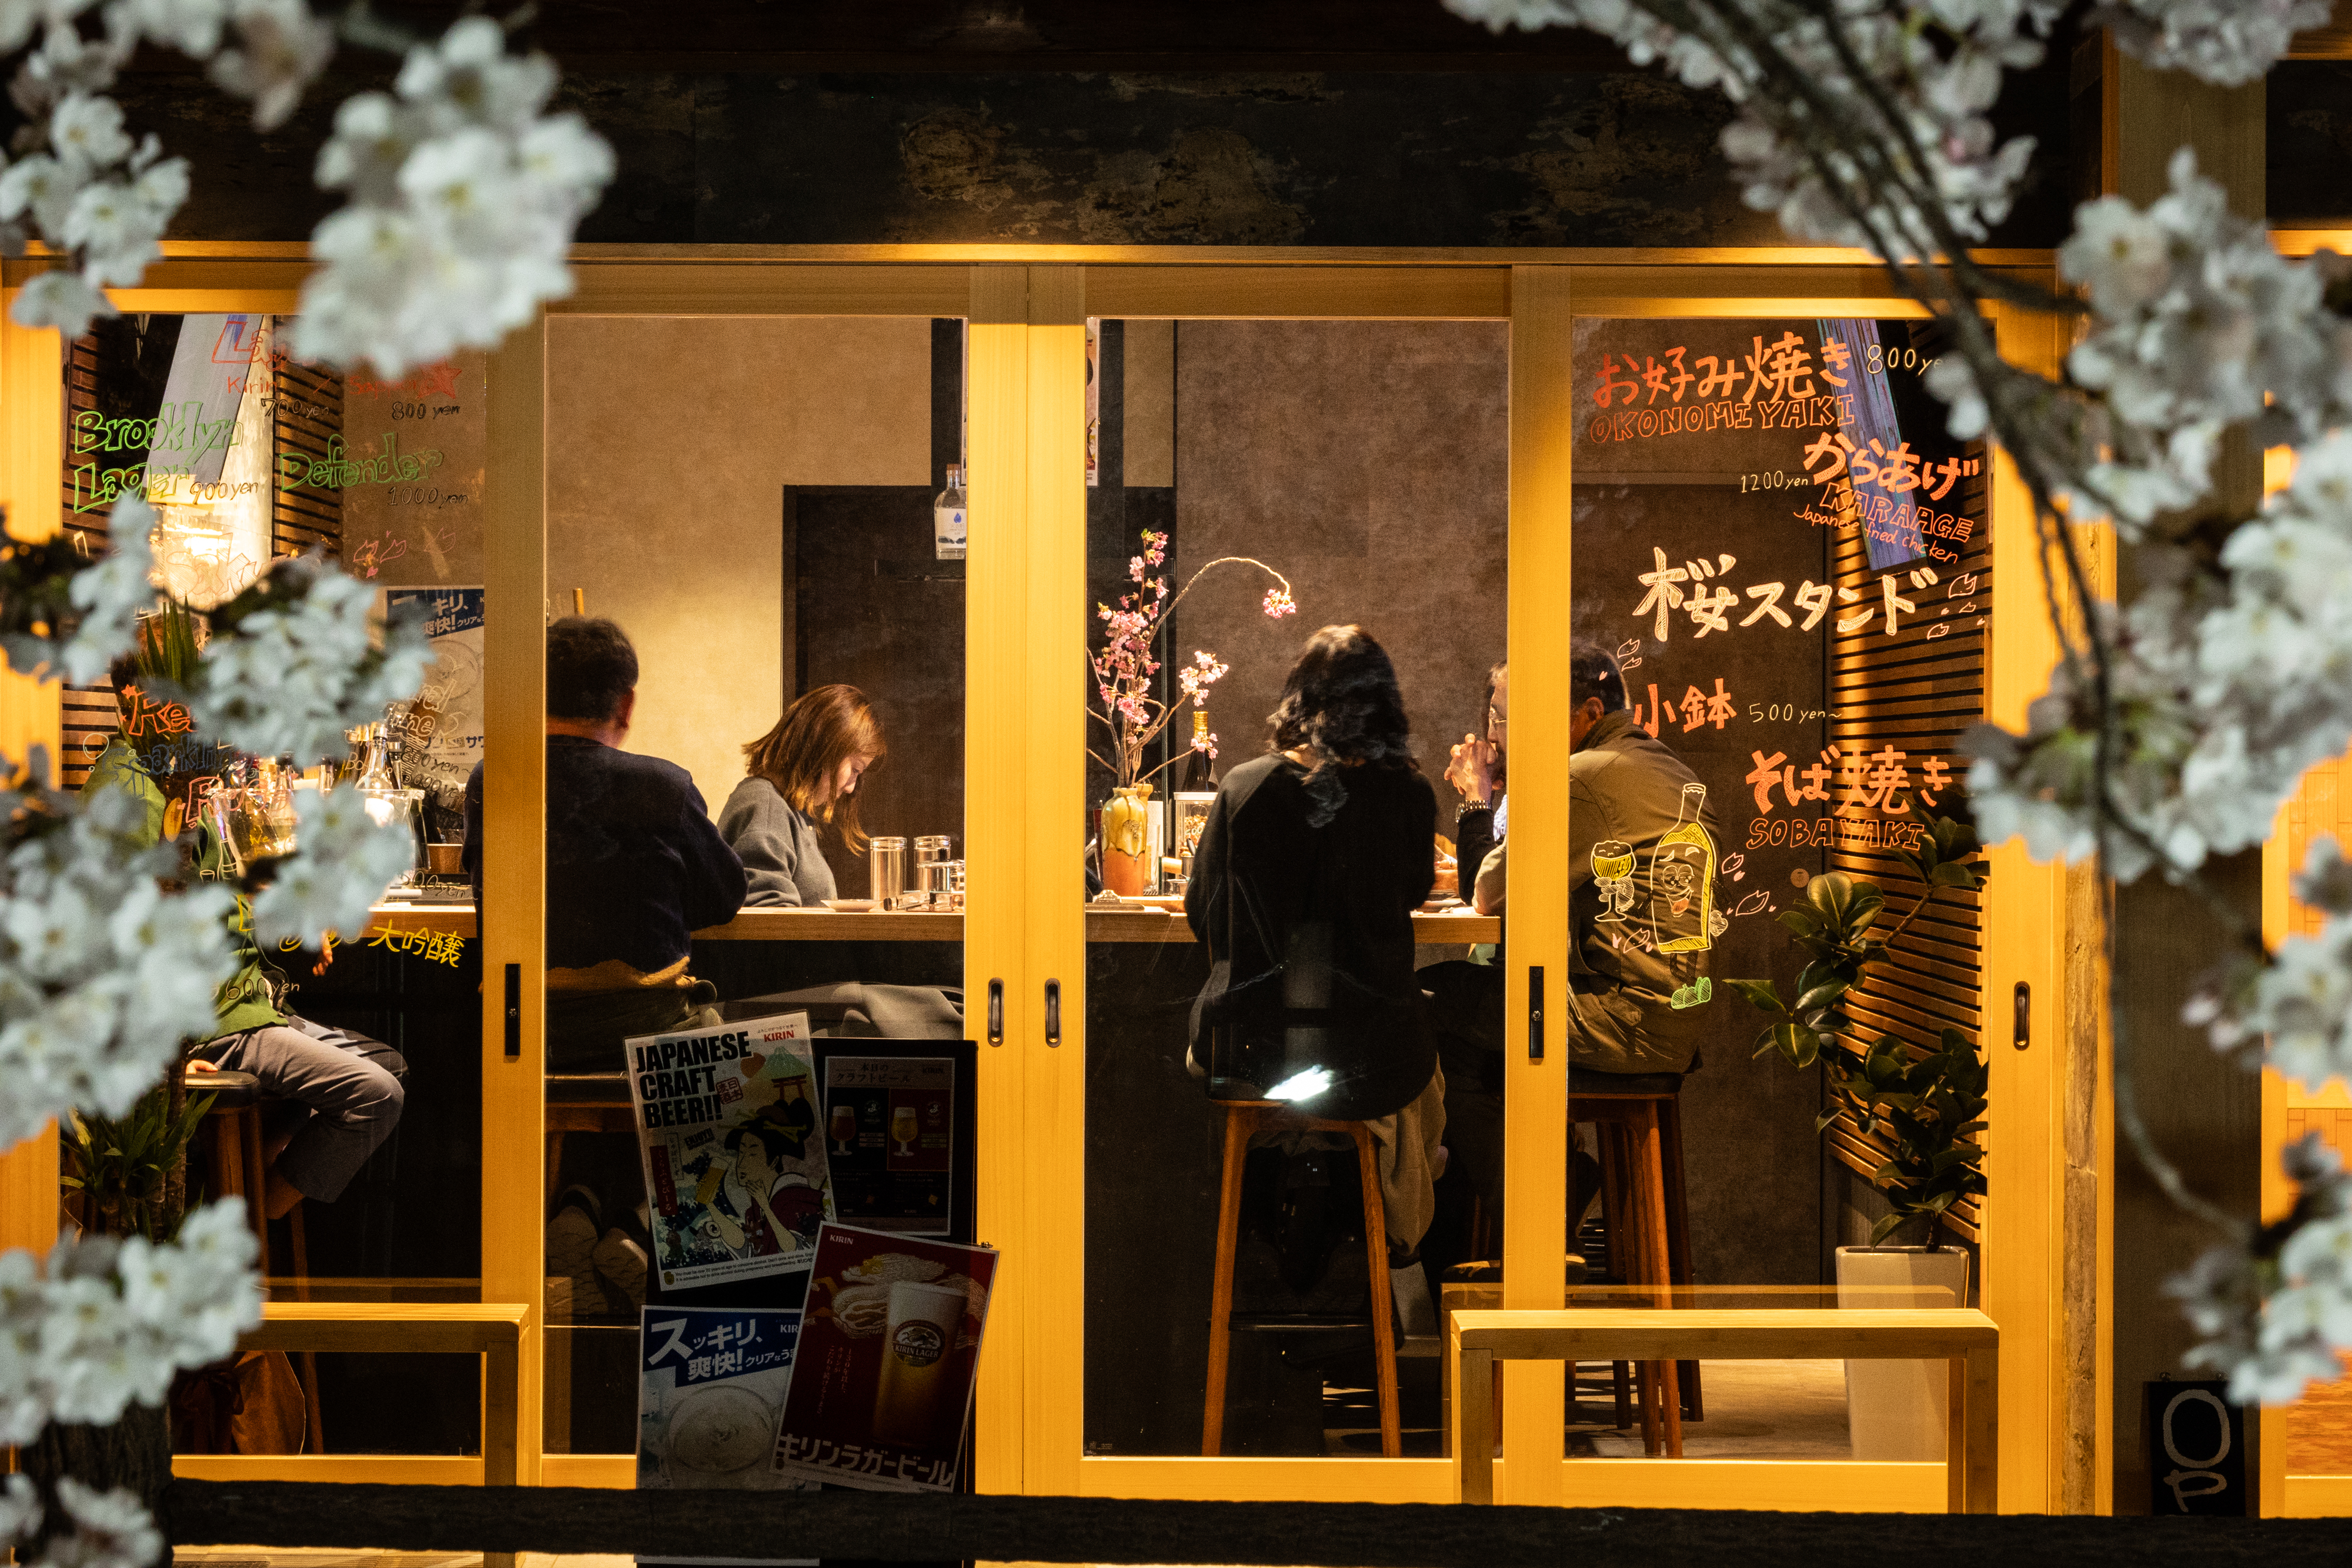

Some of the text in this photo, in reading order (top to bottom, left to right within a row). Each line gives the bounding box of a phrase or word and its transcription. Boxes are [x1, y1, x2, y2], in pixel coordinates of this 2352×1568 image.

[227, 376, 278, 394] Kirin
[1593, 331, 1852, 409] お好み焼き
[74, 401, 245, 464] Brooklyn
[1589, 394, 1855, 444] OKONOMIYAKI
[74, 460, 194, 513] Lager
[279, 432, 444, 492] Defender
[1803, 432, 1979, 501] からあげ
[1793, 503, 1958, 564] Japanese fried chicken
[1819, 482, 1975, 543] KARAAGE
[1632, 547, 1939, 642] 桜スタンド
[1632, 678, 1738, 738] 小鉢
[1749, 703, 1793, 723] 500
[1746, 744, 1953, 817] そば焼き
[1746, 818, 1925, 851] SOBAYAKI
[368, 919, 466, 968] 大吟醸
[636, 1031, 753, 1073] JAPANESE
[763, 1030, 795, 1042] KIRIN
[639, 1065, 717, 1101] CRAFT
[835, 1072, 910, 1083] クラフトビール
[860, 1062, 888, 1072] 本日の
[643, 1094, 723, 1129] BEER!!
[829, 1233, 854, 1246] KIRIN
[647, 1318, 763, 1366] スッキリ、
[895, 1344, 939, 1358] KIRIN LAGER
[776, 1433, 954, 1486] キリンラガービール
